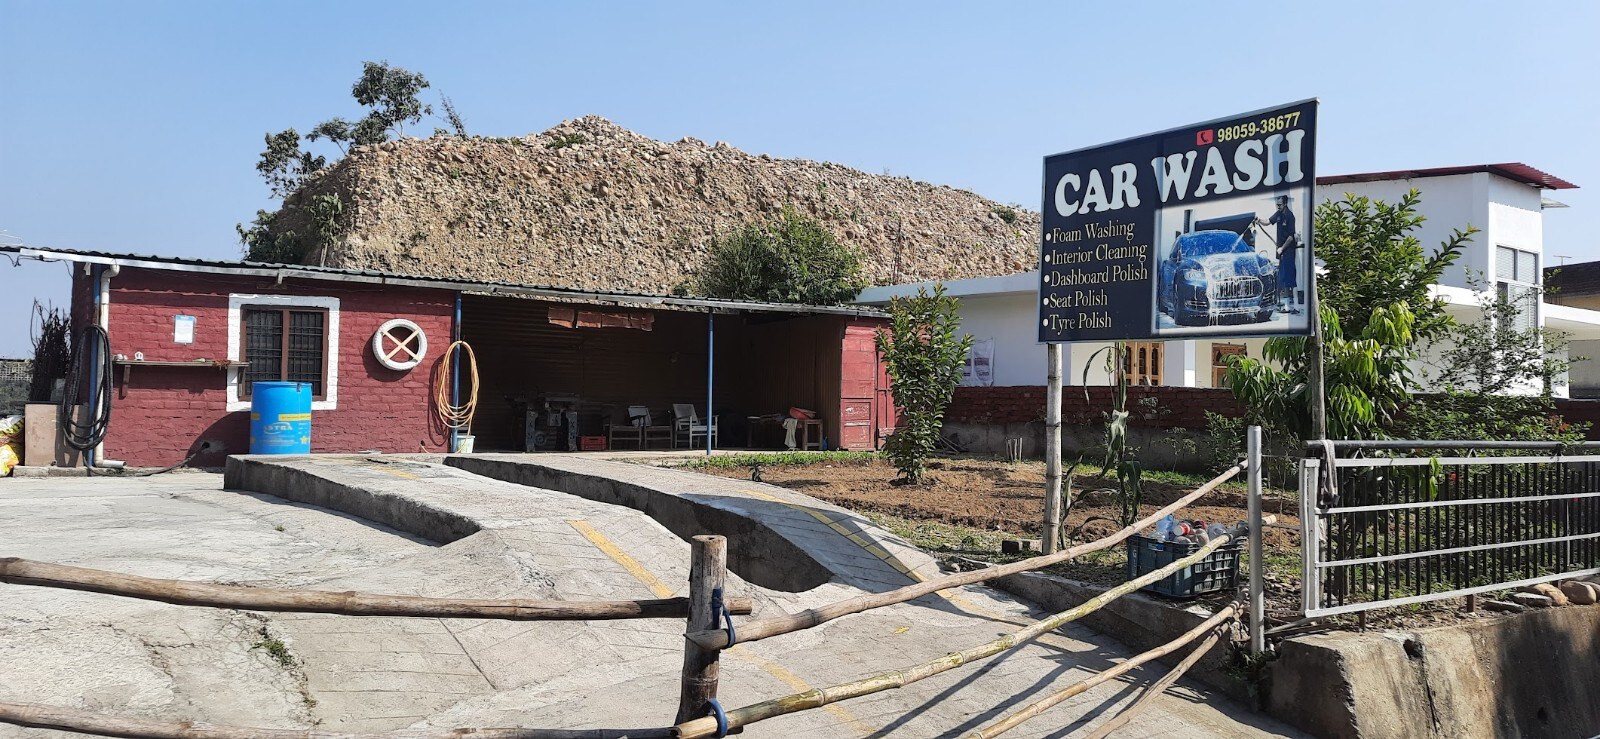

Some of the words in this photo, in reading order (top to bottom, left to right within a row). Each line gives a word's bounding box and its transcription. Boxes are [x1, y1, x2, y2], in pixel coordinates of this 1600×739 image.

[1217, 111, 1301, 143] 98059-38677
[1054, 162, 1140, 217] CAR
[1150, 129, 1305, 203] WASH
[1052, 227, 1082, 244] Foam
[1085, 219, 1135, 241] Washing
[1052, 246, 1093, 265] Interior
[1096, 241, 1148, 263] Cleaning
[1051, 266, 1109, 287] Dashboard
[1113, 263, 1148, 282] Polish
[1050, 293, 1072, 308] Seat
[1075, 289, 1108, 307] Polish
[1050, 314, 1075, 335] Tyre
[1079, 311, 1112, 329] Polish
